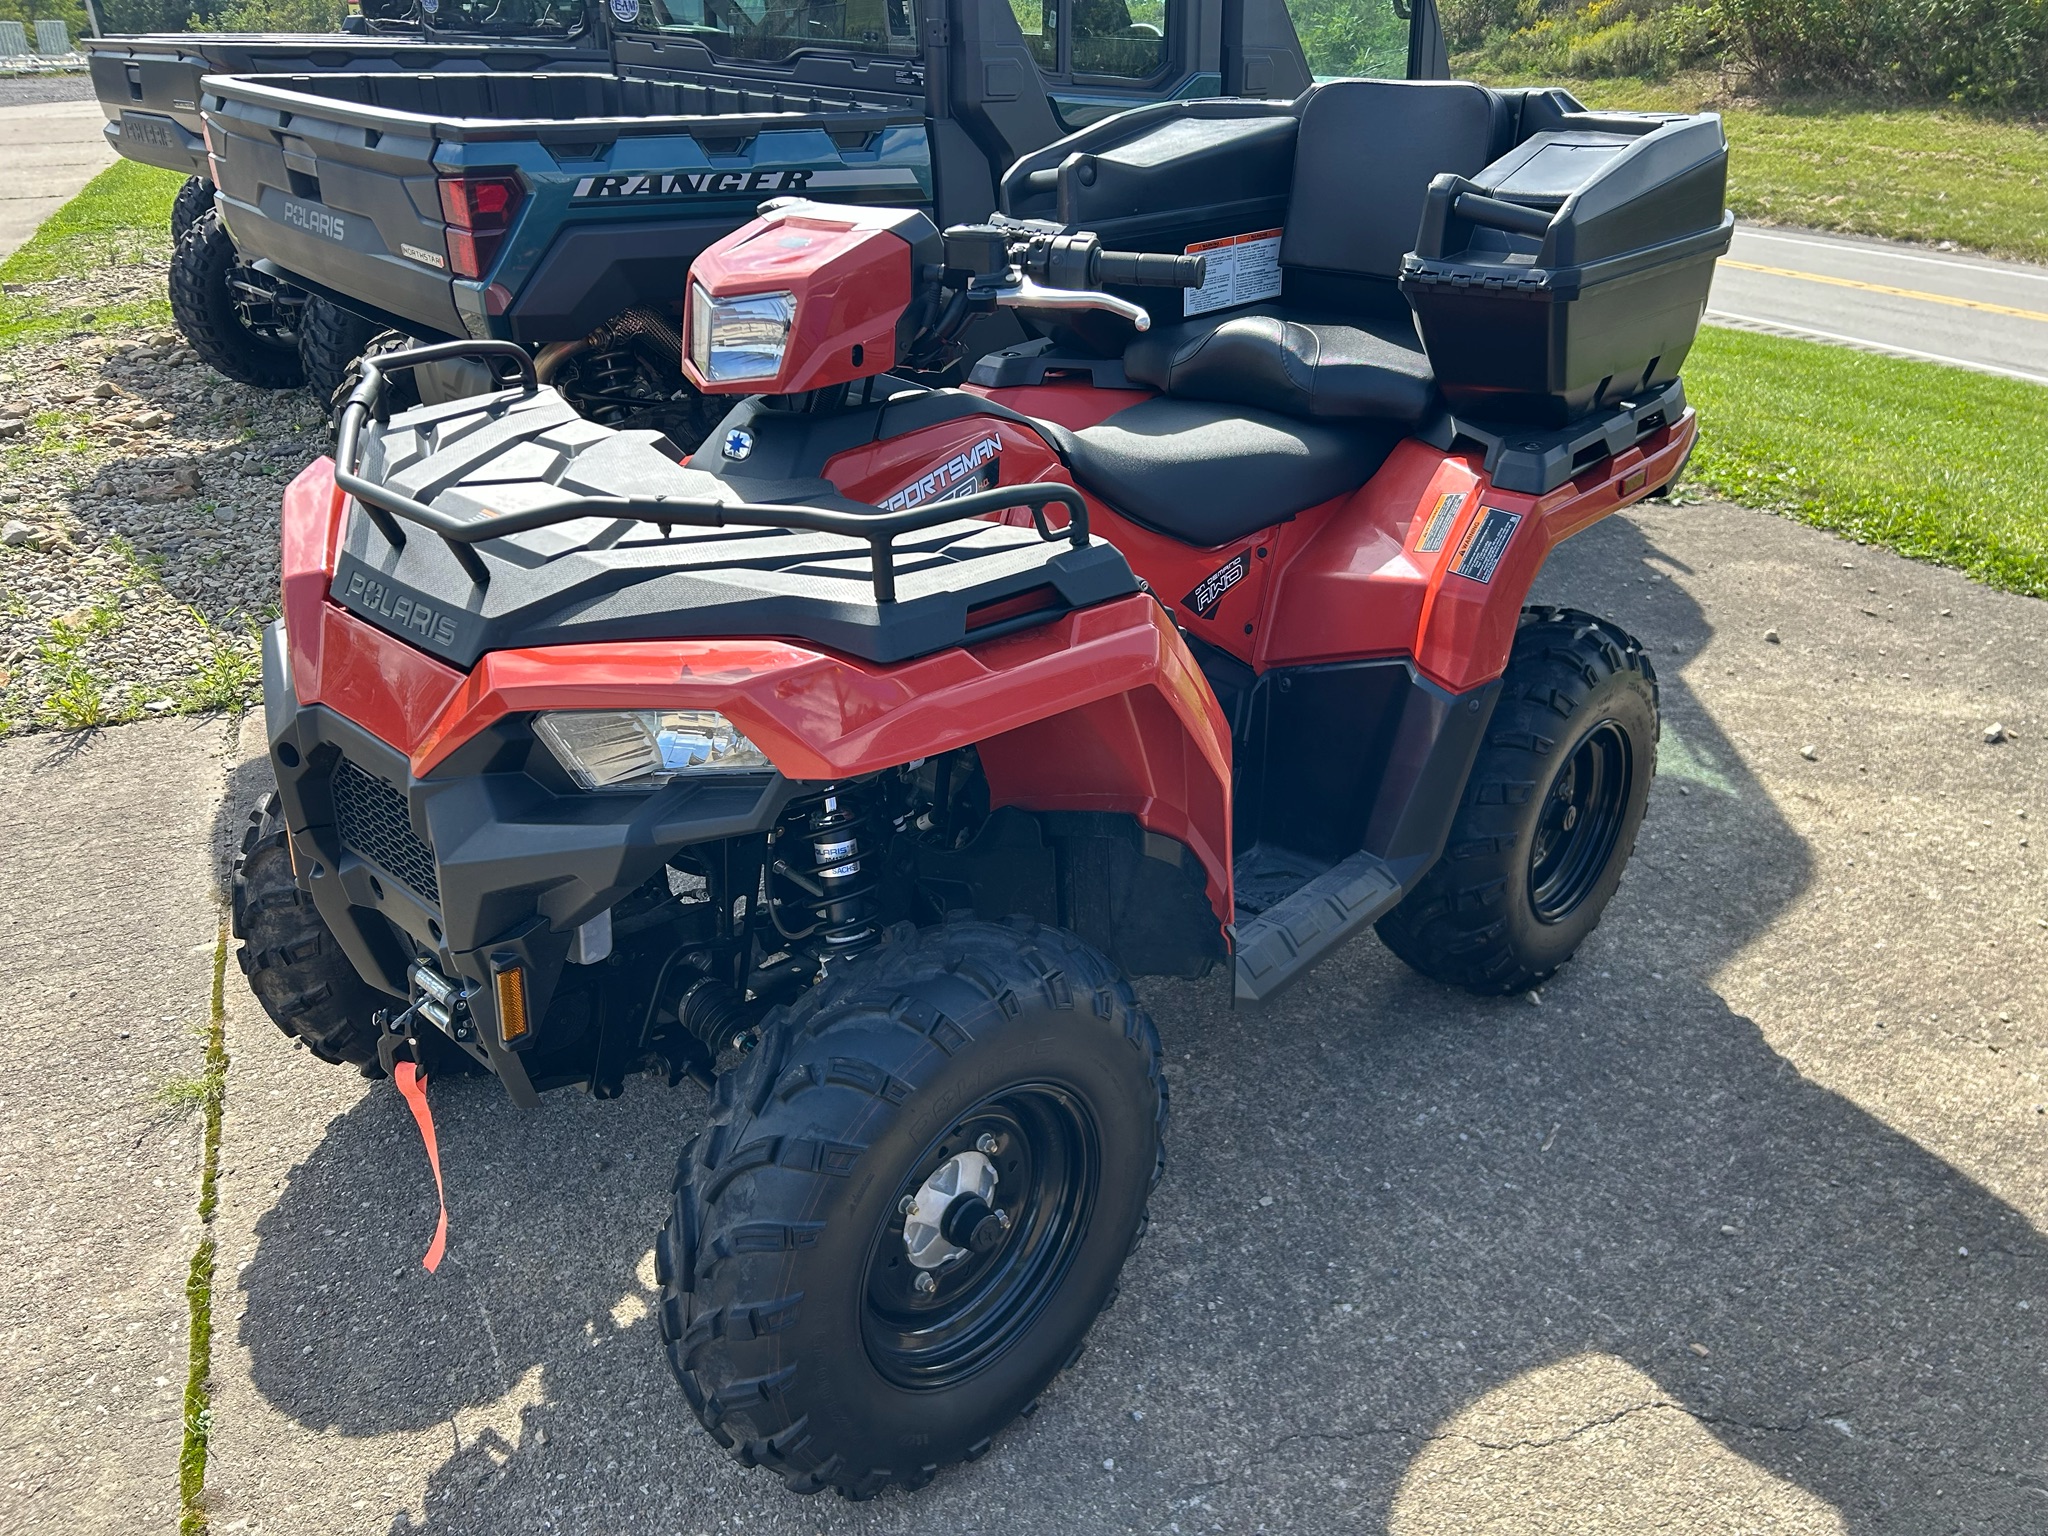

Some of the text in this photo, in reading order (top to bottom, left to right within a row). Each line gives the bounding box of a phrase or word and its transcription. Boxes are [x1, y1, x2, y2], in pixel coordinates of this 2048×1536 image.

[586, 170, 814, 199] RANGER
[284, 202, 345, 241] POLARIS
[402, 246, 441, 264] NORTHSTAR
[1461, 520, 1481, 551] WARNING
[1194, 556, 1241, 596] ON DEMAND
[1197, 564, 1243, 612] AWD
[345, 570, 458, 647] POLARIS
